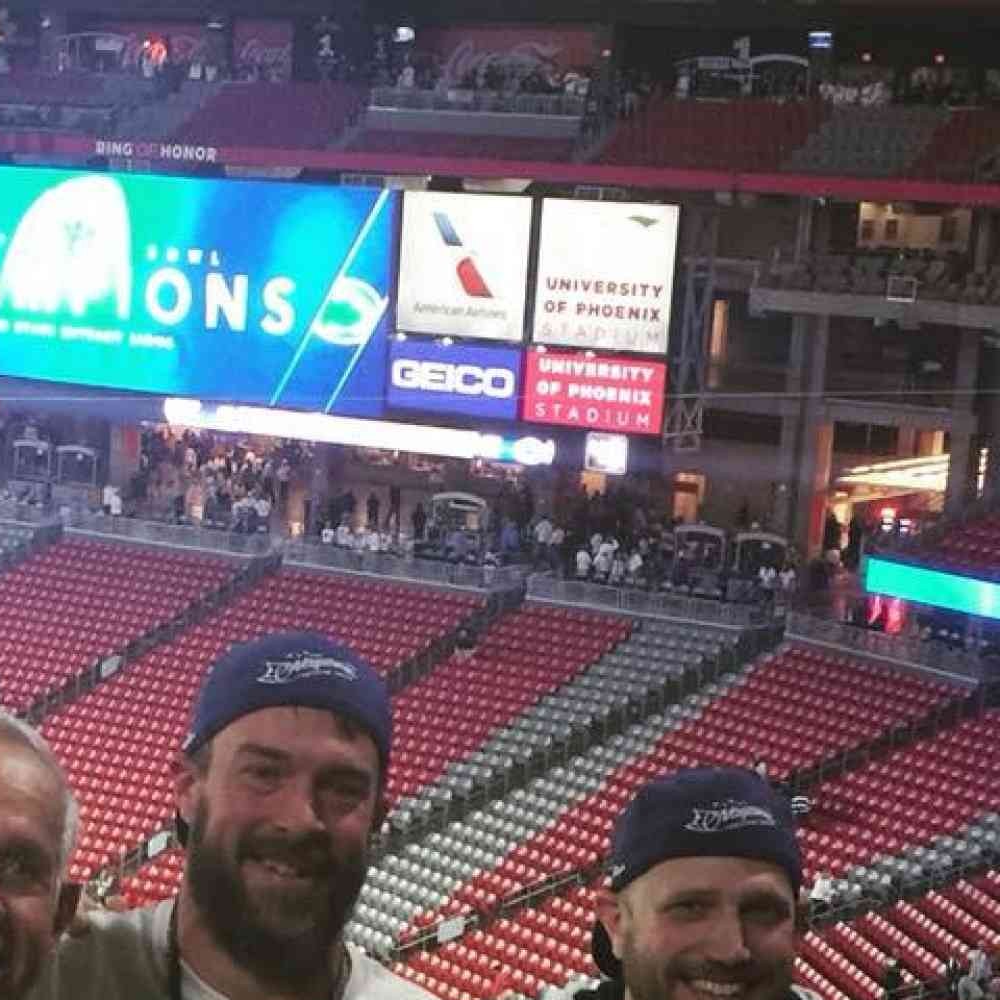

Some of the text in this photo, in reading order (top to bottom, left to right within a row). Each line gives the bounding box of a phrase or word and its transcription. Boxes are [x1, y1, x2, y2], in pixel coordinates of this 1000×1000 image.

[95, 140, 133, 157] RING
[160, 144, 218, 163] HONOR
[546, 276, 664, 299] UNIVERSITY
[543, 300, 661, 322] OF PHOENIX
[391, 358, 516, 399] GEICO
[537, 356, 654, 382] UNIVERSITY
[536, 382, 651, 406] OF PHOENIX
[534, 403, 650, 427] STADIUM
